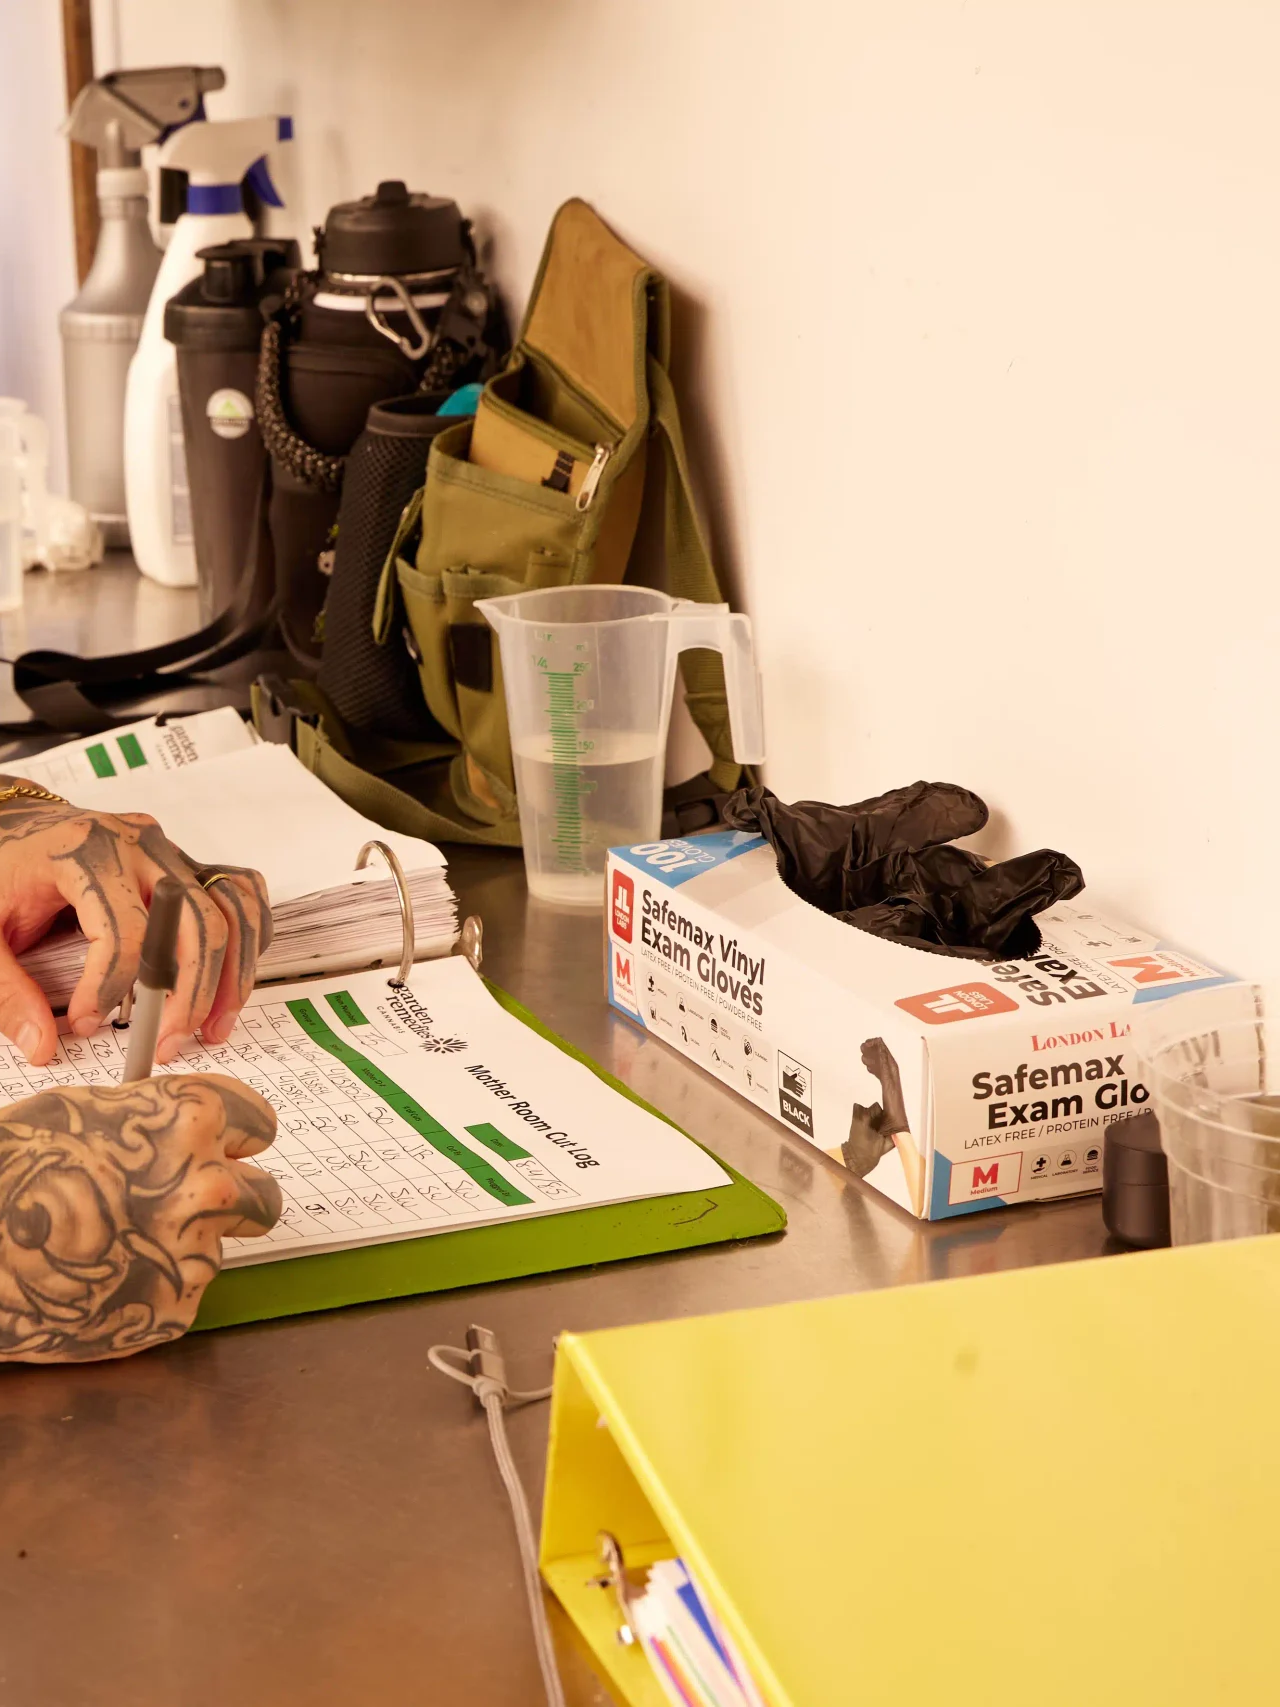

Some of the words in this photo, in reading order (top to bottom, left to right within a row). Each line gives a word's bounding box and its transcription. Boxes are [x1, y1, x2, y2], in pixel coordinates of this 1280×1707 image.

[629, 843, 697, 873] 100
[642, 889, 714, 955] Safemax
[719, 934, 765, 986] Vinyl
[616, 952, 631, 986] M
[641, 916, 691, 972] Exam
[697, 952, 763, 1016] Gloves
[974, 959, 1067, 1006] Safe
[392, 985, 433, 1025] garden
[641, 947, 657, 964] LATEX
[657, 958, 671, 973] FREE
[675, 968, 700, 992] PROTEIN
[700, 984, 715, 1002] FREE
[719, 997, 746, 1021] POWDER
[746, 1014, 763, 1032] FREE
[376, 1005, 406, 1034] CANNABIS
[385, 996, 435, 1039] remedies
[972, 1054, 1126, 1100] Safemax
[464, 1064, 516, 1100] Mother
[508, 1101, 552, 1131] Room
[545, 1132, 579, 1148] Cut
[568, 1148, 600, 1169] Log
[782, 1099, 811, 1128] BLACK
[988, 1095, 1083, 1130] Exam
[1094, 1079, 1150, 1110] Glo
[964, 1134, 1002, 1150] LATEX
[1005, 1128, 1036, 1143] FREE
[1046, 1118, 1099, 1135] PROTEIN
[970, 1185, 998, 1195] Medium
[972, 1163, 999, 1188] M
